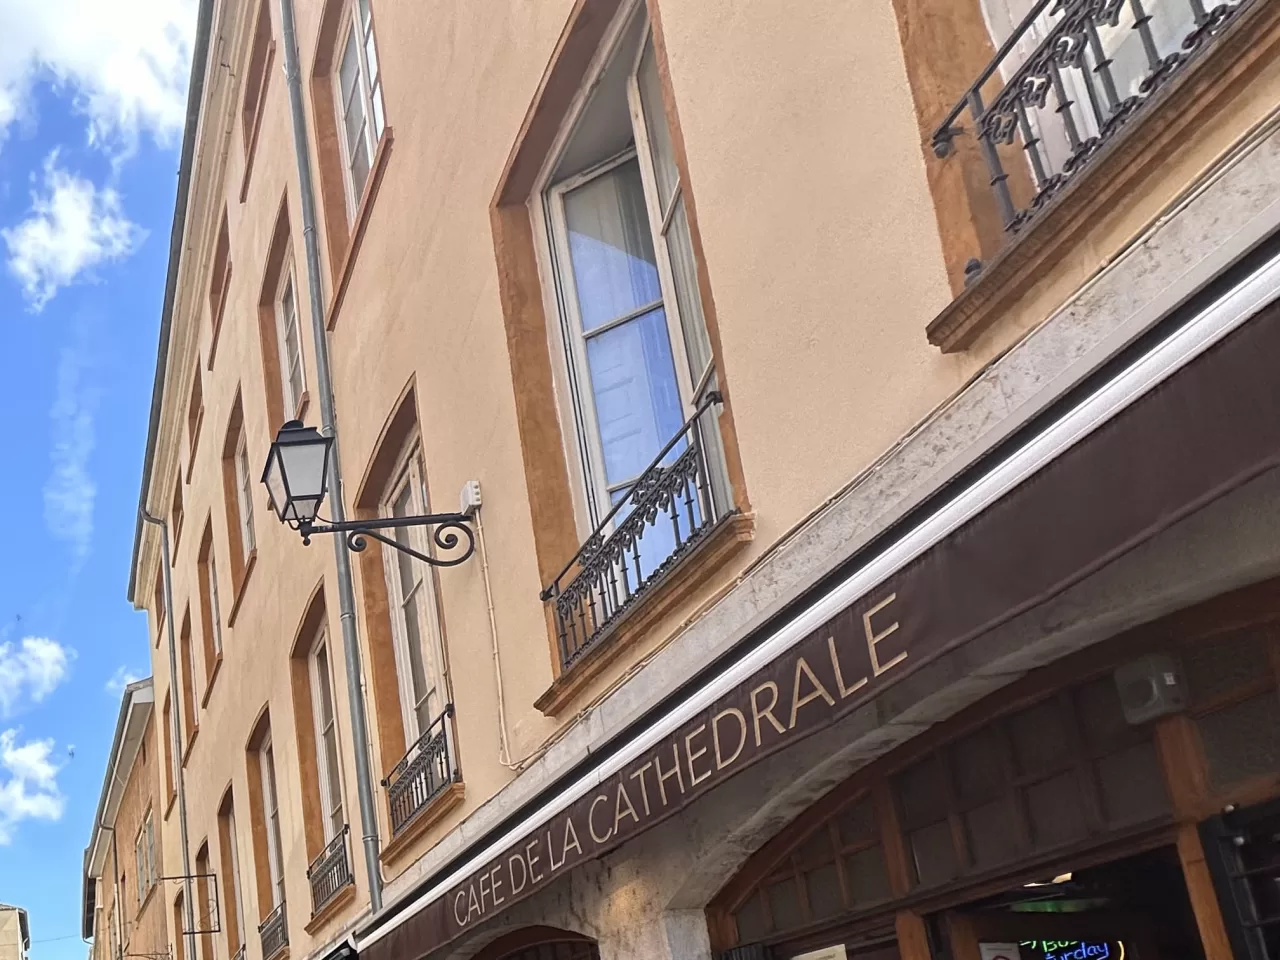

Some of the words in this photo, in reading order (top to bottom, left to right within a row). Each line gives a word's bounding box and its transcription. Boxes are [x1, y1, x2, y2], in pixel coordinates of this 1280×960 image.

[454, 864, 505, 926] CAFE
[509, 839, 543, 895] DE
[547, 817, 582, 871] LA
[588, 592, 908, 843] CATHEDRALE
